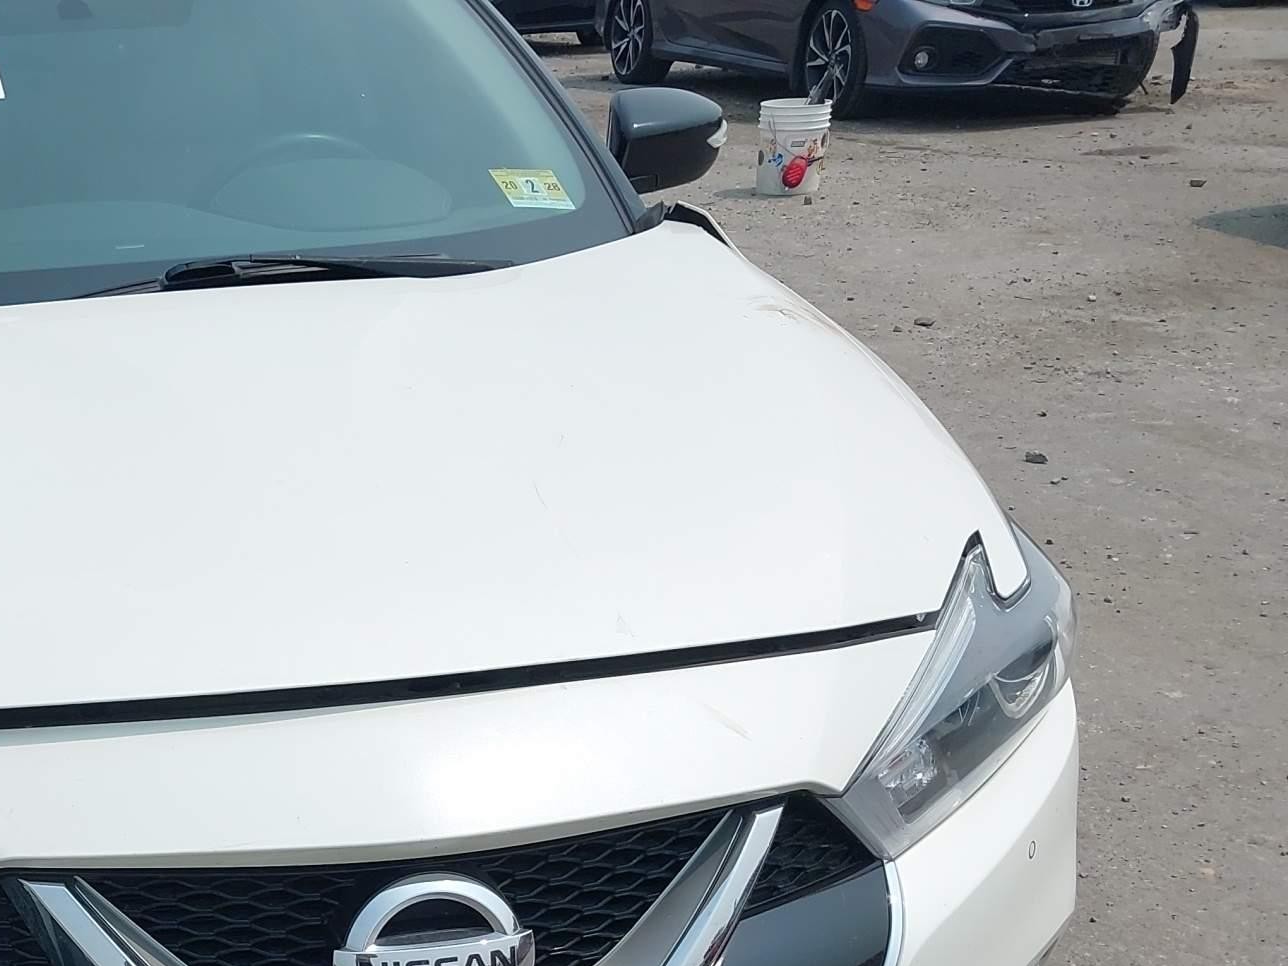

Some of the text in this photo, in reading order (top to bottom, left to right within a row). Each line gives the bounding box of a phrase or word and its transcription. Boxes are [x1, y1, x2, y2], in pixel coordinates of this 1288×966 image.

[501, 179, 561, 193] 20 2 28
